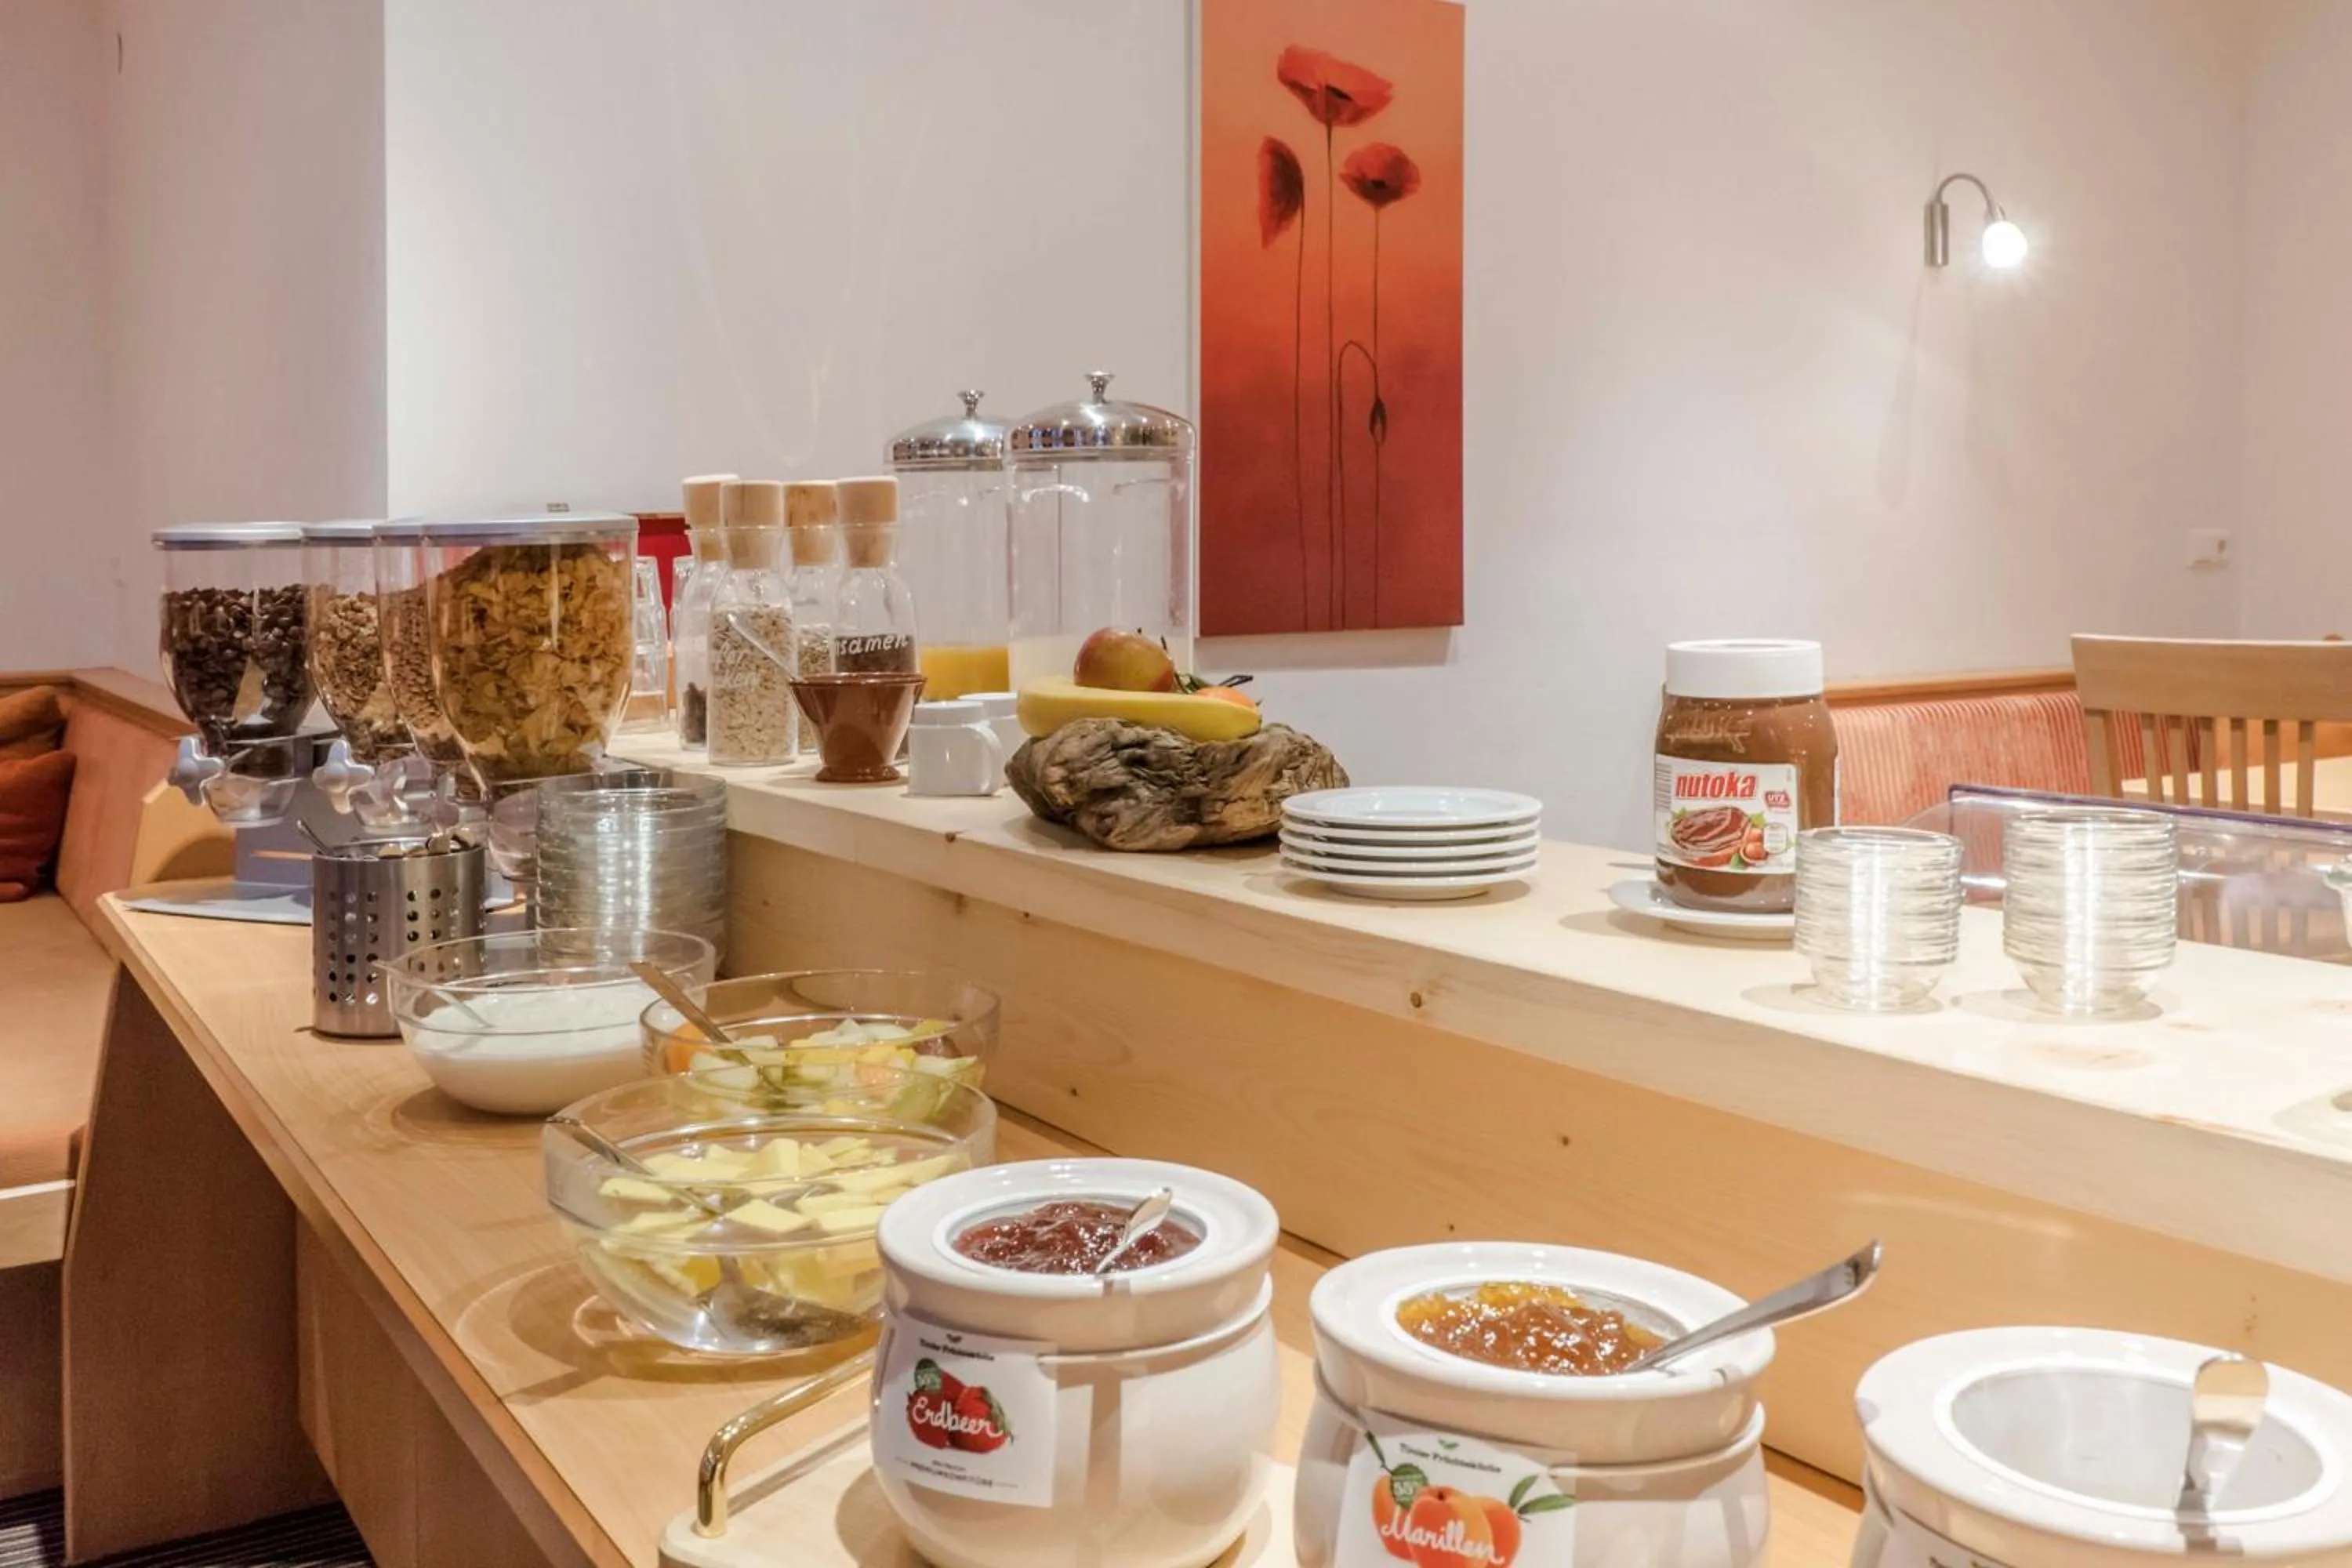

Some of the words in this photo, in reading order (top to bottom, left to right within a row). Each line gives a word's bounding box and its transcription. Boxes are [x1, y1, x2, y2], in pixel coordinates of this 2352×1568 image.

[1676, 771, 1756, 798] nutoka
[912, 1396, 1004, 1437] Erdbeer
[1381, 1504, 1505, 1564] Marillen
